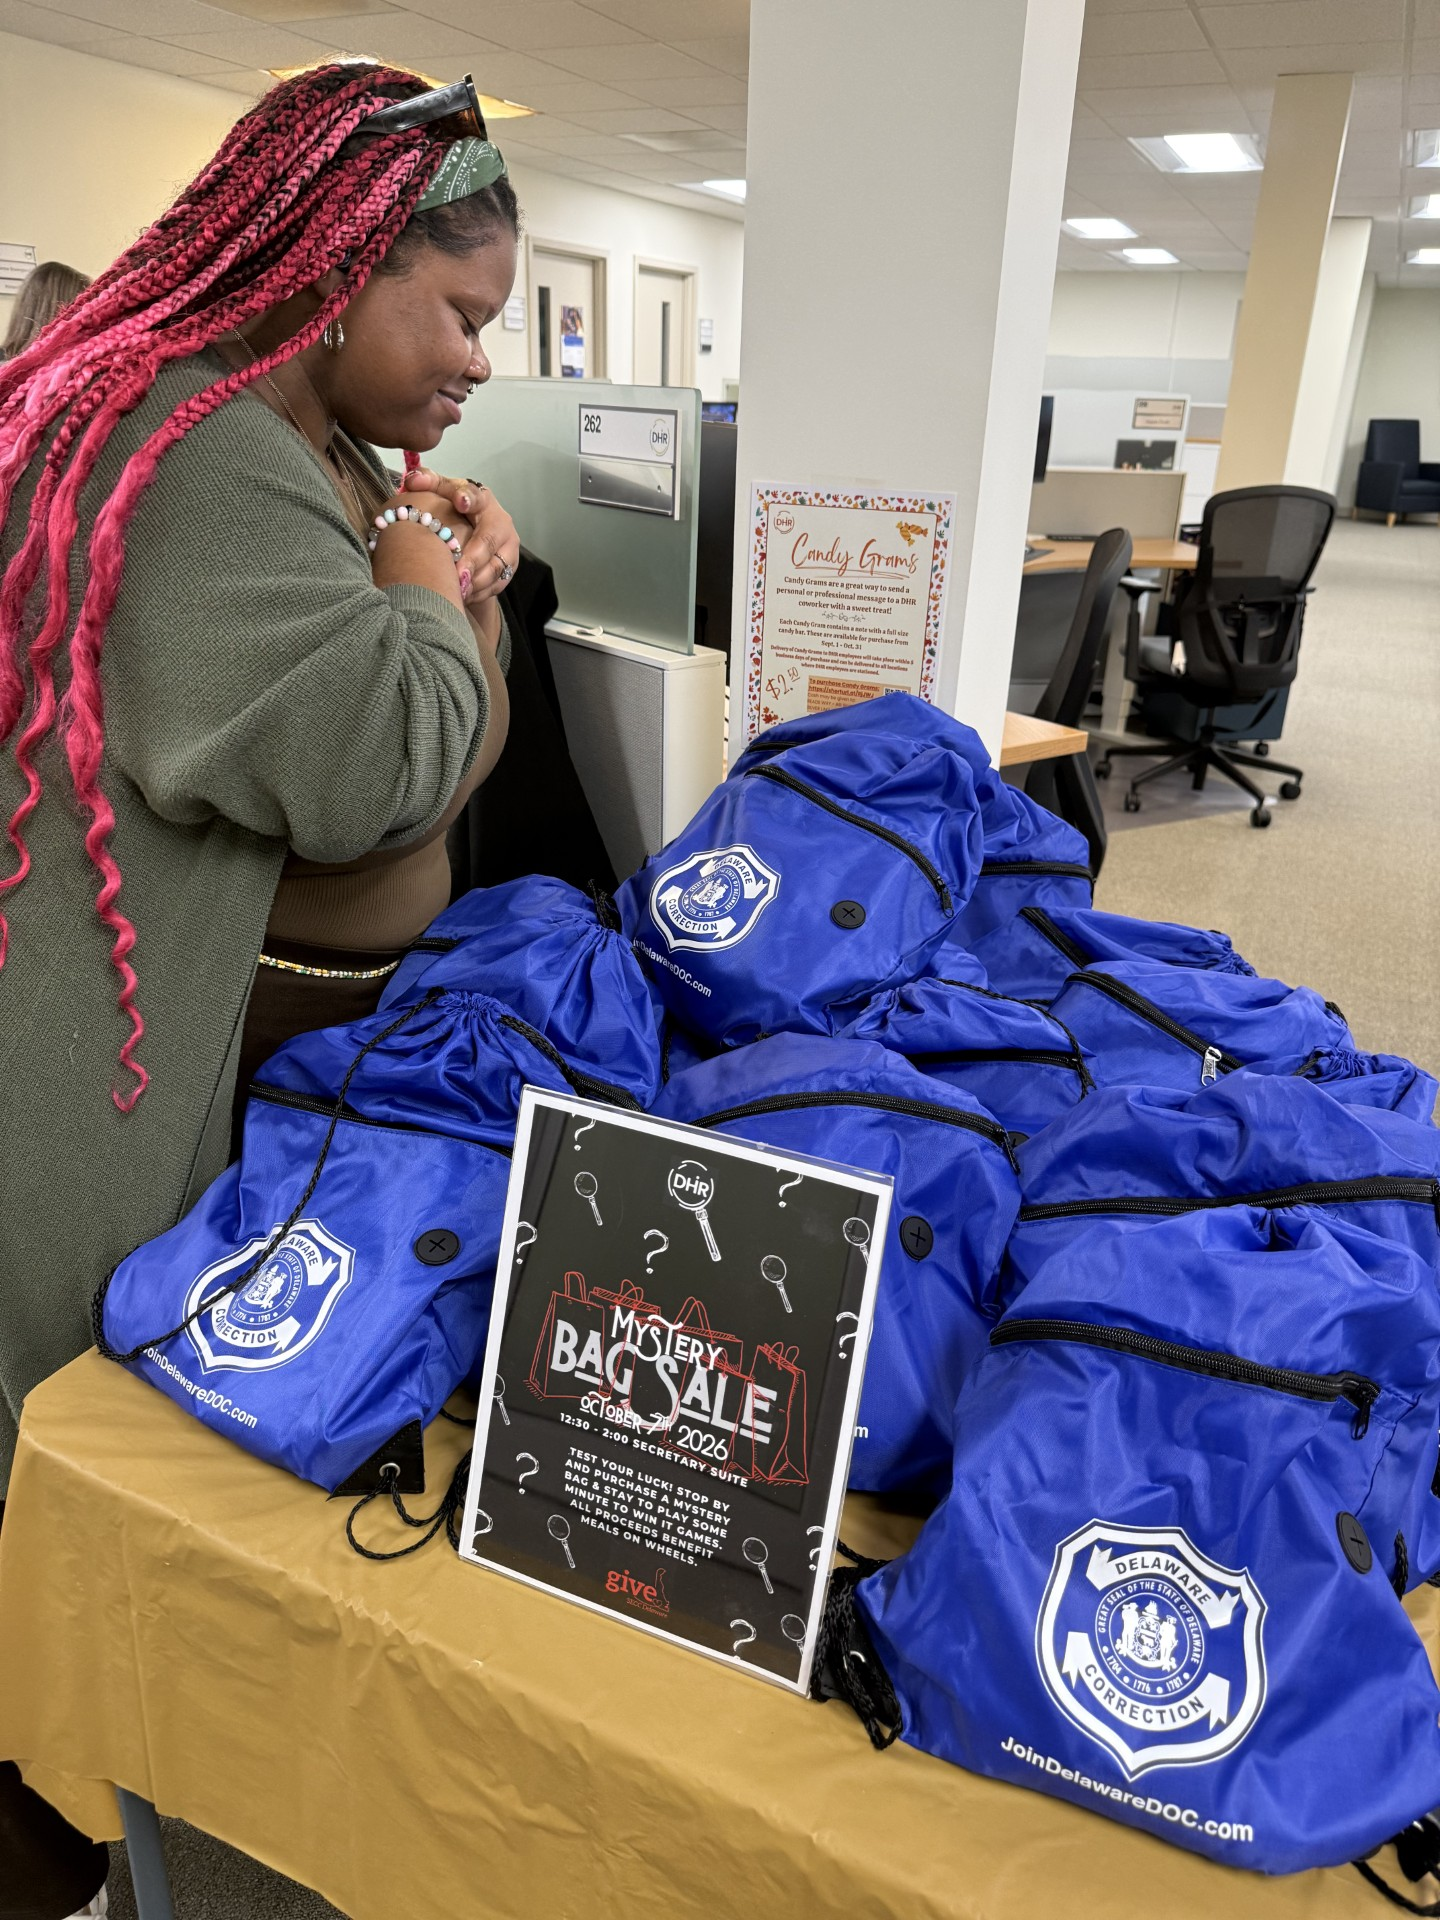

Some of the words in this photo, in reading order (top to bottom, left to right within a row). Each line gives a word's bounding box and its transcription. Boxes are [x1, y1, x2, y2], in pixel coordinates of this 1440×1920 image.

[584, 414, 601, 433] 262
[652, 431, 668, 444] DHR
[776, 518, 792, 526] DHR
[792, 532, 853, 576] Candy
[859, 538, 918, 576] Grams
[784, 576, 805, 586] Candy
[806, 578, 828, 586] Grams
[864, 584, 879, 592] way
[798, 600, 829, 608] coworker
[830, 602, 846, 610] with
[814, 590, 856, 600] professional
[856, 595, 886, 604] message
[821, 640, 835, 648] Sept.
[868, 636, 893, 644] purchase
[669, 898, 717, 931] CORRECTION
[633, 937, 712, 997] inDelawareDOC.com
[674, 1173, 709, 1198] DHR
[611, 1305, 723, 1370] MYSTERY
[550, 1319, 636, 1395] BAG
[621, 1354, 777, 1444] SALE
[560, 1413, 590, 1431] 12:30
[602, 1428, 629, 1444] 2:00
[632, 1439, 706, 1472] SECRETARY
[710, 1466, 748, 1488] SUITE
[579, 1391, 641, 1434] OCTOBER
[677, 1425, 728, 1460] 2026
[564, 1471, 588, 1486] BAG
[592, 1482, 600, 1490] &
[604, 1485, 634, 1502] STAY
[638, 1498, 653, 1510] TO
[657, 1505, 689, 1523] PLAY
[692, 1519, 728, 1538] SOME
[565, 1459, 590, 1474] AND
[594, 1469, 657, 1499] PURCHASE
[661, 1494, 669, 1504] A
[674, 1498, 731, 1526] MYSTERY
[570, 1446, 598, 1464] TEST
[602, 1458, 634, 1477] YOUR
[638, 1472, 673, 1492] LUCK!
[677, 1487, 709, 1504] STOP
[713, 1499, 730, 1512] BY
[565, 1484, 609, 1507] MINUTE
[613, 1502, 628, 1513] TO
[633, 1509, 657, 1525] WIN
[661, 1520, 673, 1530] IT
[677, 1526, 723, 1550] GAMES.
[570, 1499, 591, 1513] ALL
[595, 1508, 658, 1538] PROCEEDS
[662, 1533, 714, 1558] BENEFIT
[581, 1515, 619, 1536] MEALS
[623, 1532, 640, 1544] ON
[645, 1539, 698, 1567] WHEELS.
[605, 1570, 657, 1602] give
[1115, 1556, 1210, 1605] DELAWARE
[1098, 1604, 1110, 1633] GREAT
[1107, 1589, 1126, 1605] SEAL
[1128, 1584, 1138, 1593] OF
[1140, 1581, 1155, 1590] THE
[1158, 1584, 1180, 1604] STATE
[1180, 1604, 1190, 1615] OF
[1186, 1615, 1201, 1664] DELAWARE
[1085, 1663, 1204, 1725] CORRECTION
[1107, 1655, 1122, 1675] 1704
[1133, 1679, 1150, 1693] 1776
[1166, 1676, 1183, 1692] 1787
[1000, 1736, 1254, 1842] JoinDelawareDOC.com
